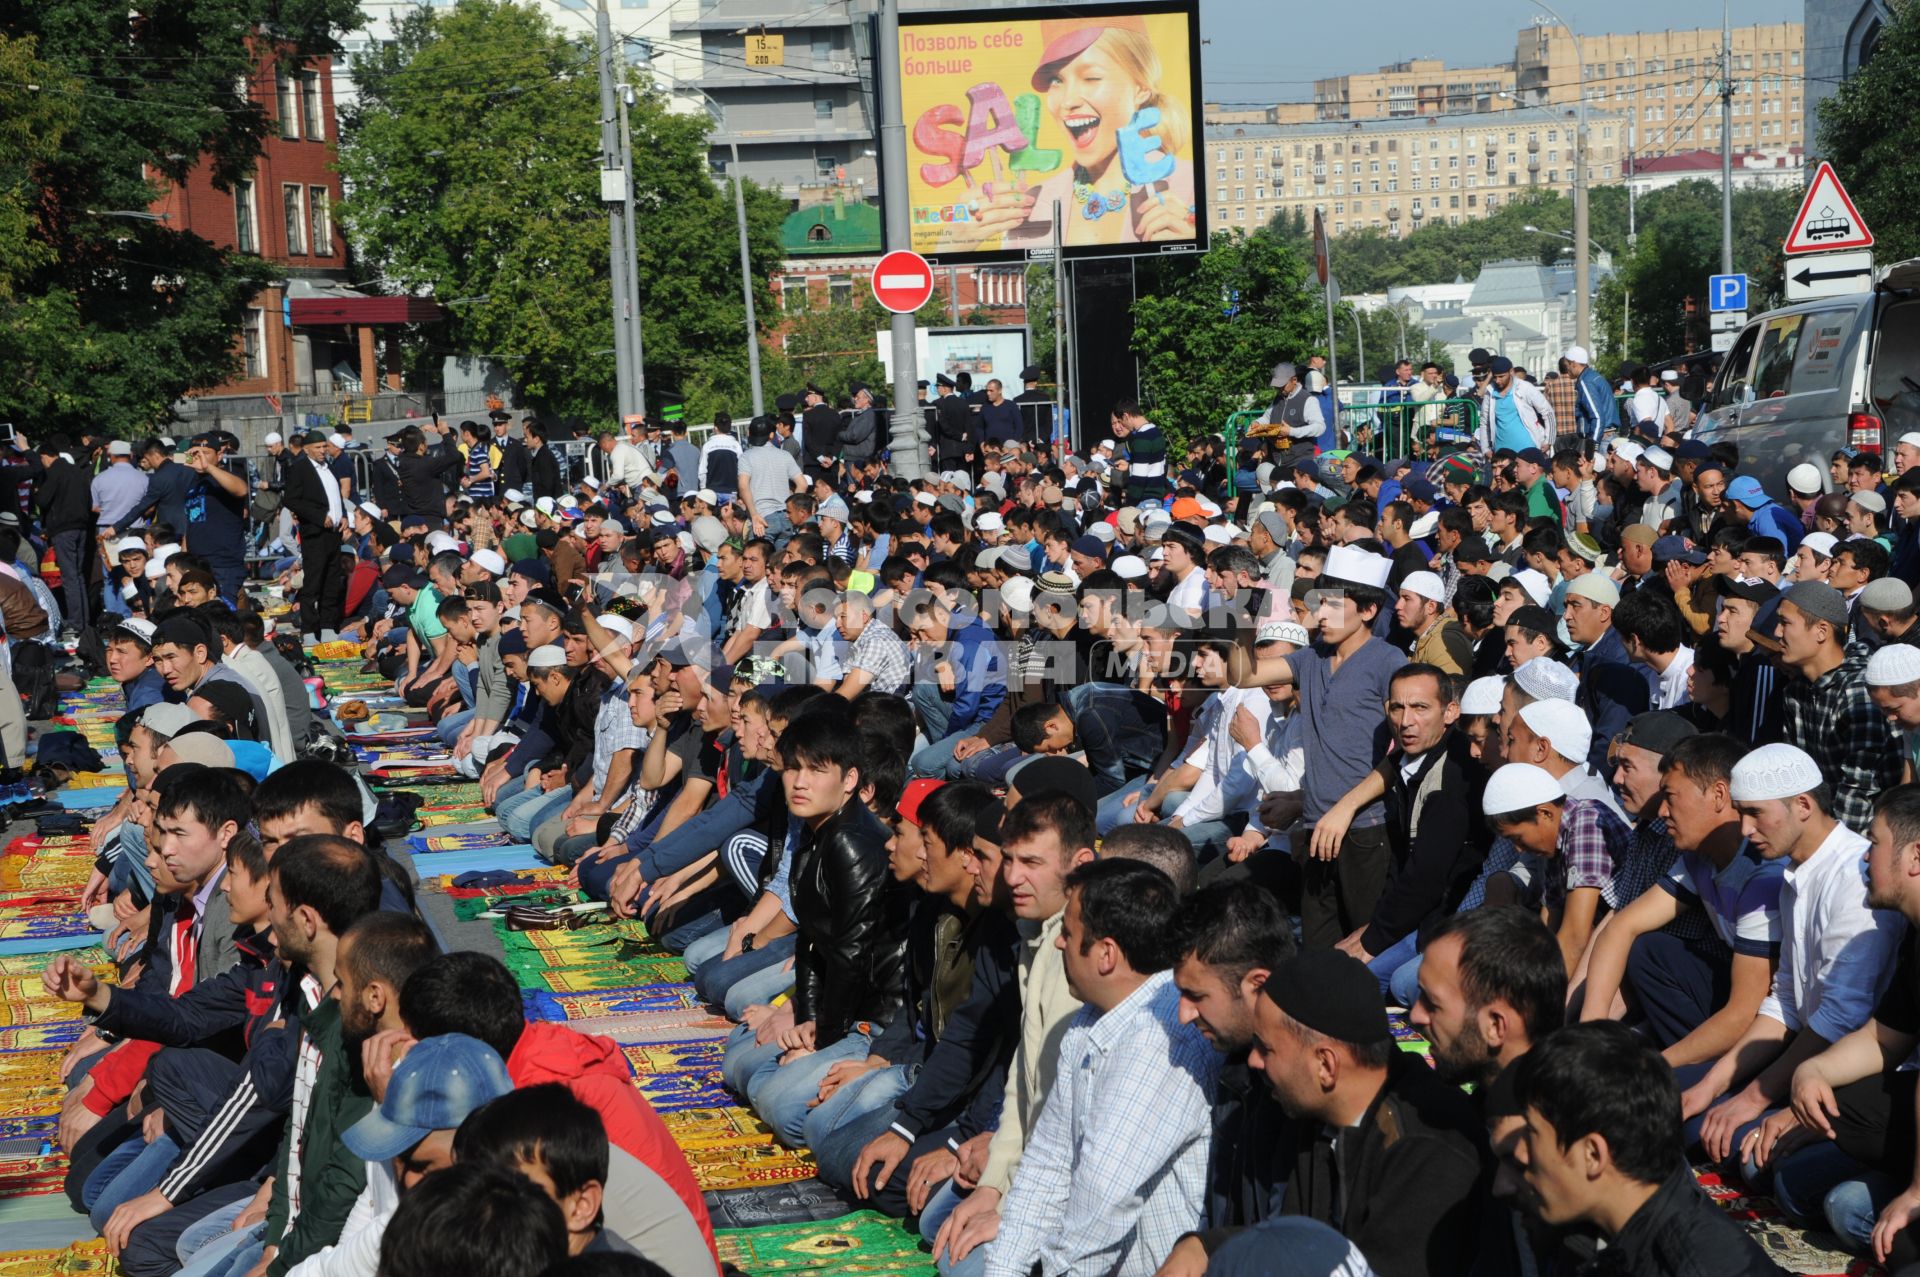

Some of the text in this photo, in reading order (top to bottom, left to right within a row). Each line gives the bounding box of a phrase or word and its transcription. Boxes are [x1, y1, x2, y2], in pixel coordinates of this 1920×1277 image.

[756, 39, 766, 50] 15
[903, 28, 1023, 52] Позволь себе
[755, 55, 769, 65] 200
[904, 56, 972, 76] больше
[913, 82, 1176, 188] SALE
[914, 228, 952, 238] megamall.ru
